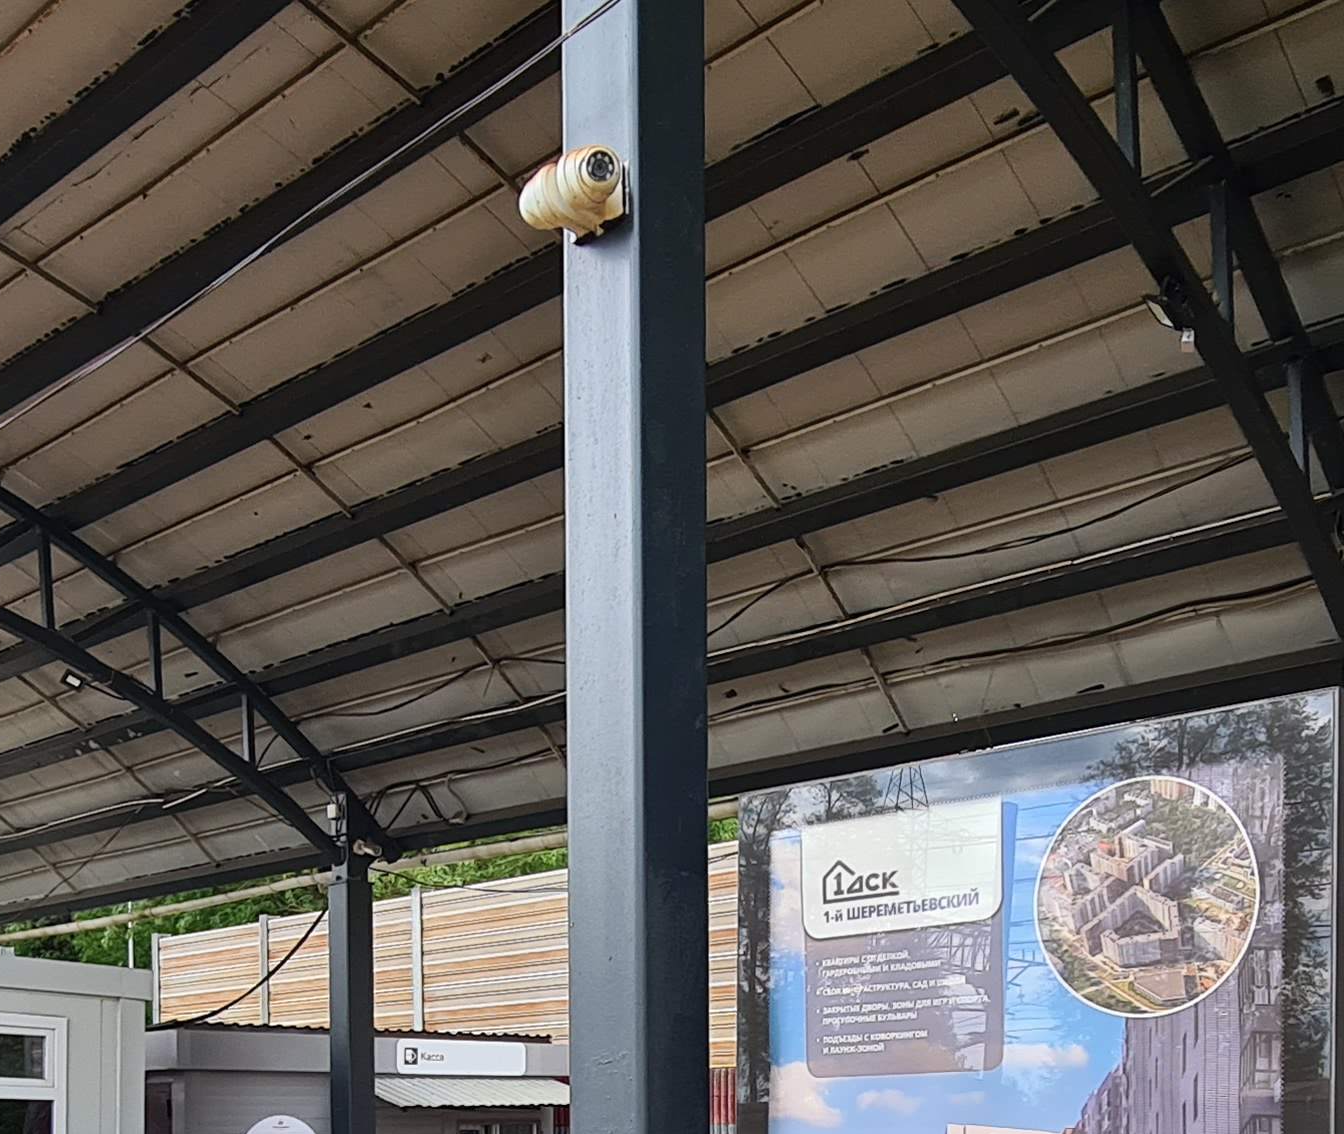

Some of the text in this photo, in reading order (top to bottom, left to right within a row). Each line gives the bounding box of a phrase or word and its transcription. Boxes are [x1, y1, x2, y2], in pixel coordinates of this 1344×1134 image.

[823, 888, 979, 923] 1-й ШЕРЕМЕТЬЕВСКИЙ
[420, 1052, 445, 1061] Касса
